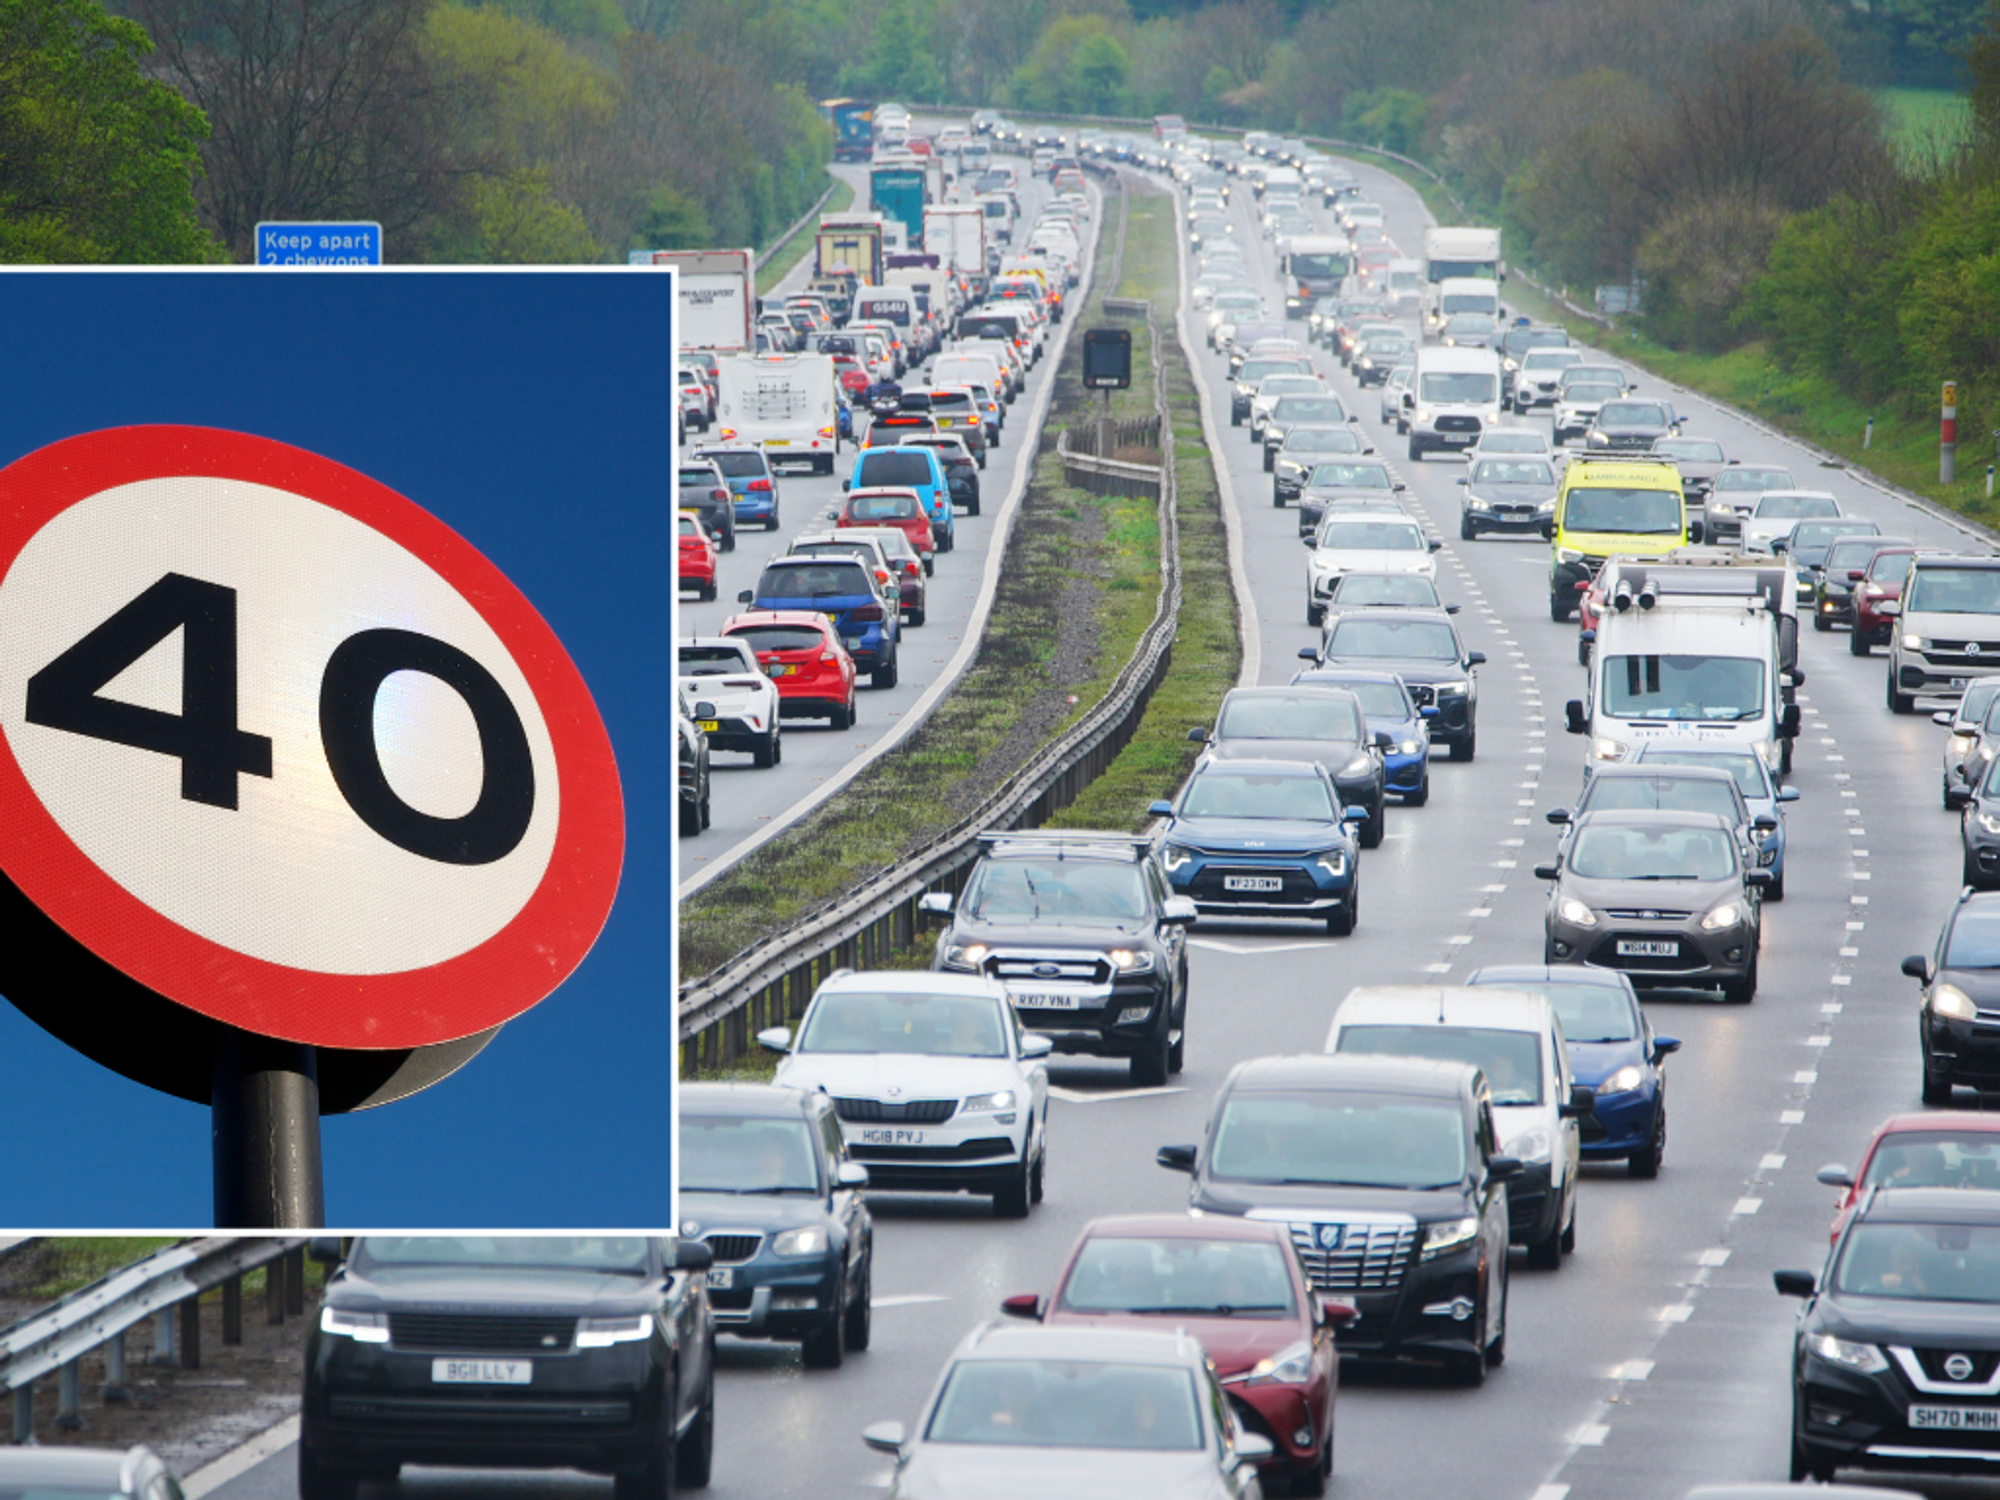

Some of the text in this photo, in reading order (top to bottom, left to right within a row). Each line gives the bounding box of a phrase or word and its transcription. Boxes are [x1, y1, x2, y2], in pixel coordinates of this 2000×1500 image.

[265, 232, 371, 251] Keep apart
[266, 252, 369, 266] 2 chevrons
[26, 572, 536, 866] 40
[1019, 994, 1072, 1007] RX17 VNA
[863, 1129, 924, 1144] HG18 PVJ
[482, 1363, 517, 1380] LLY
[1916, 1408, 1998, 1429] SH70 MHH
